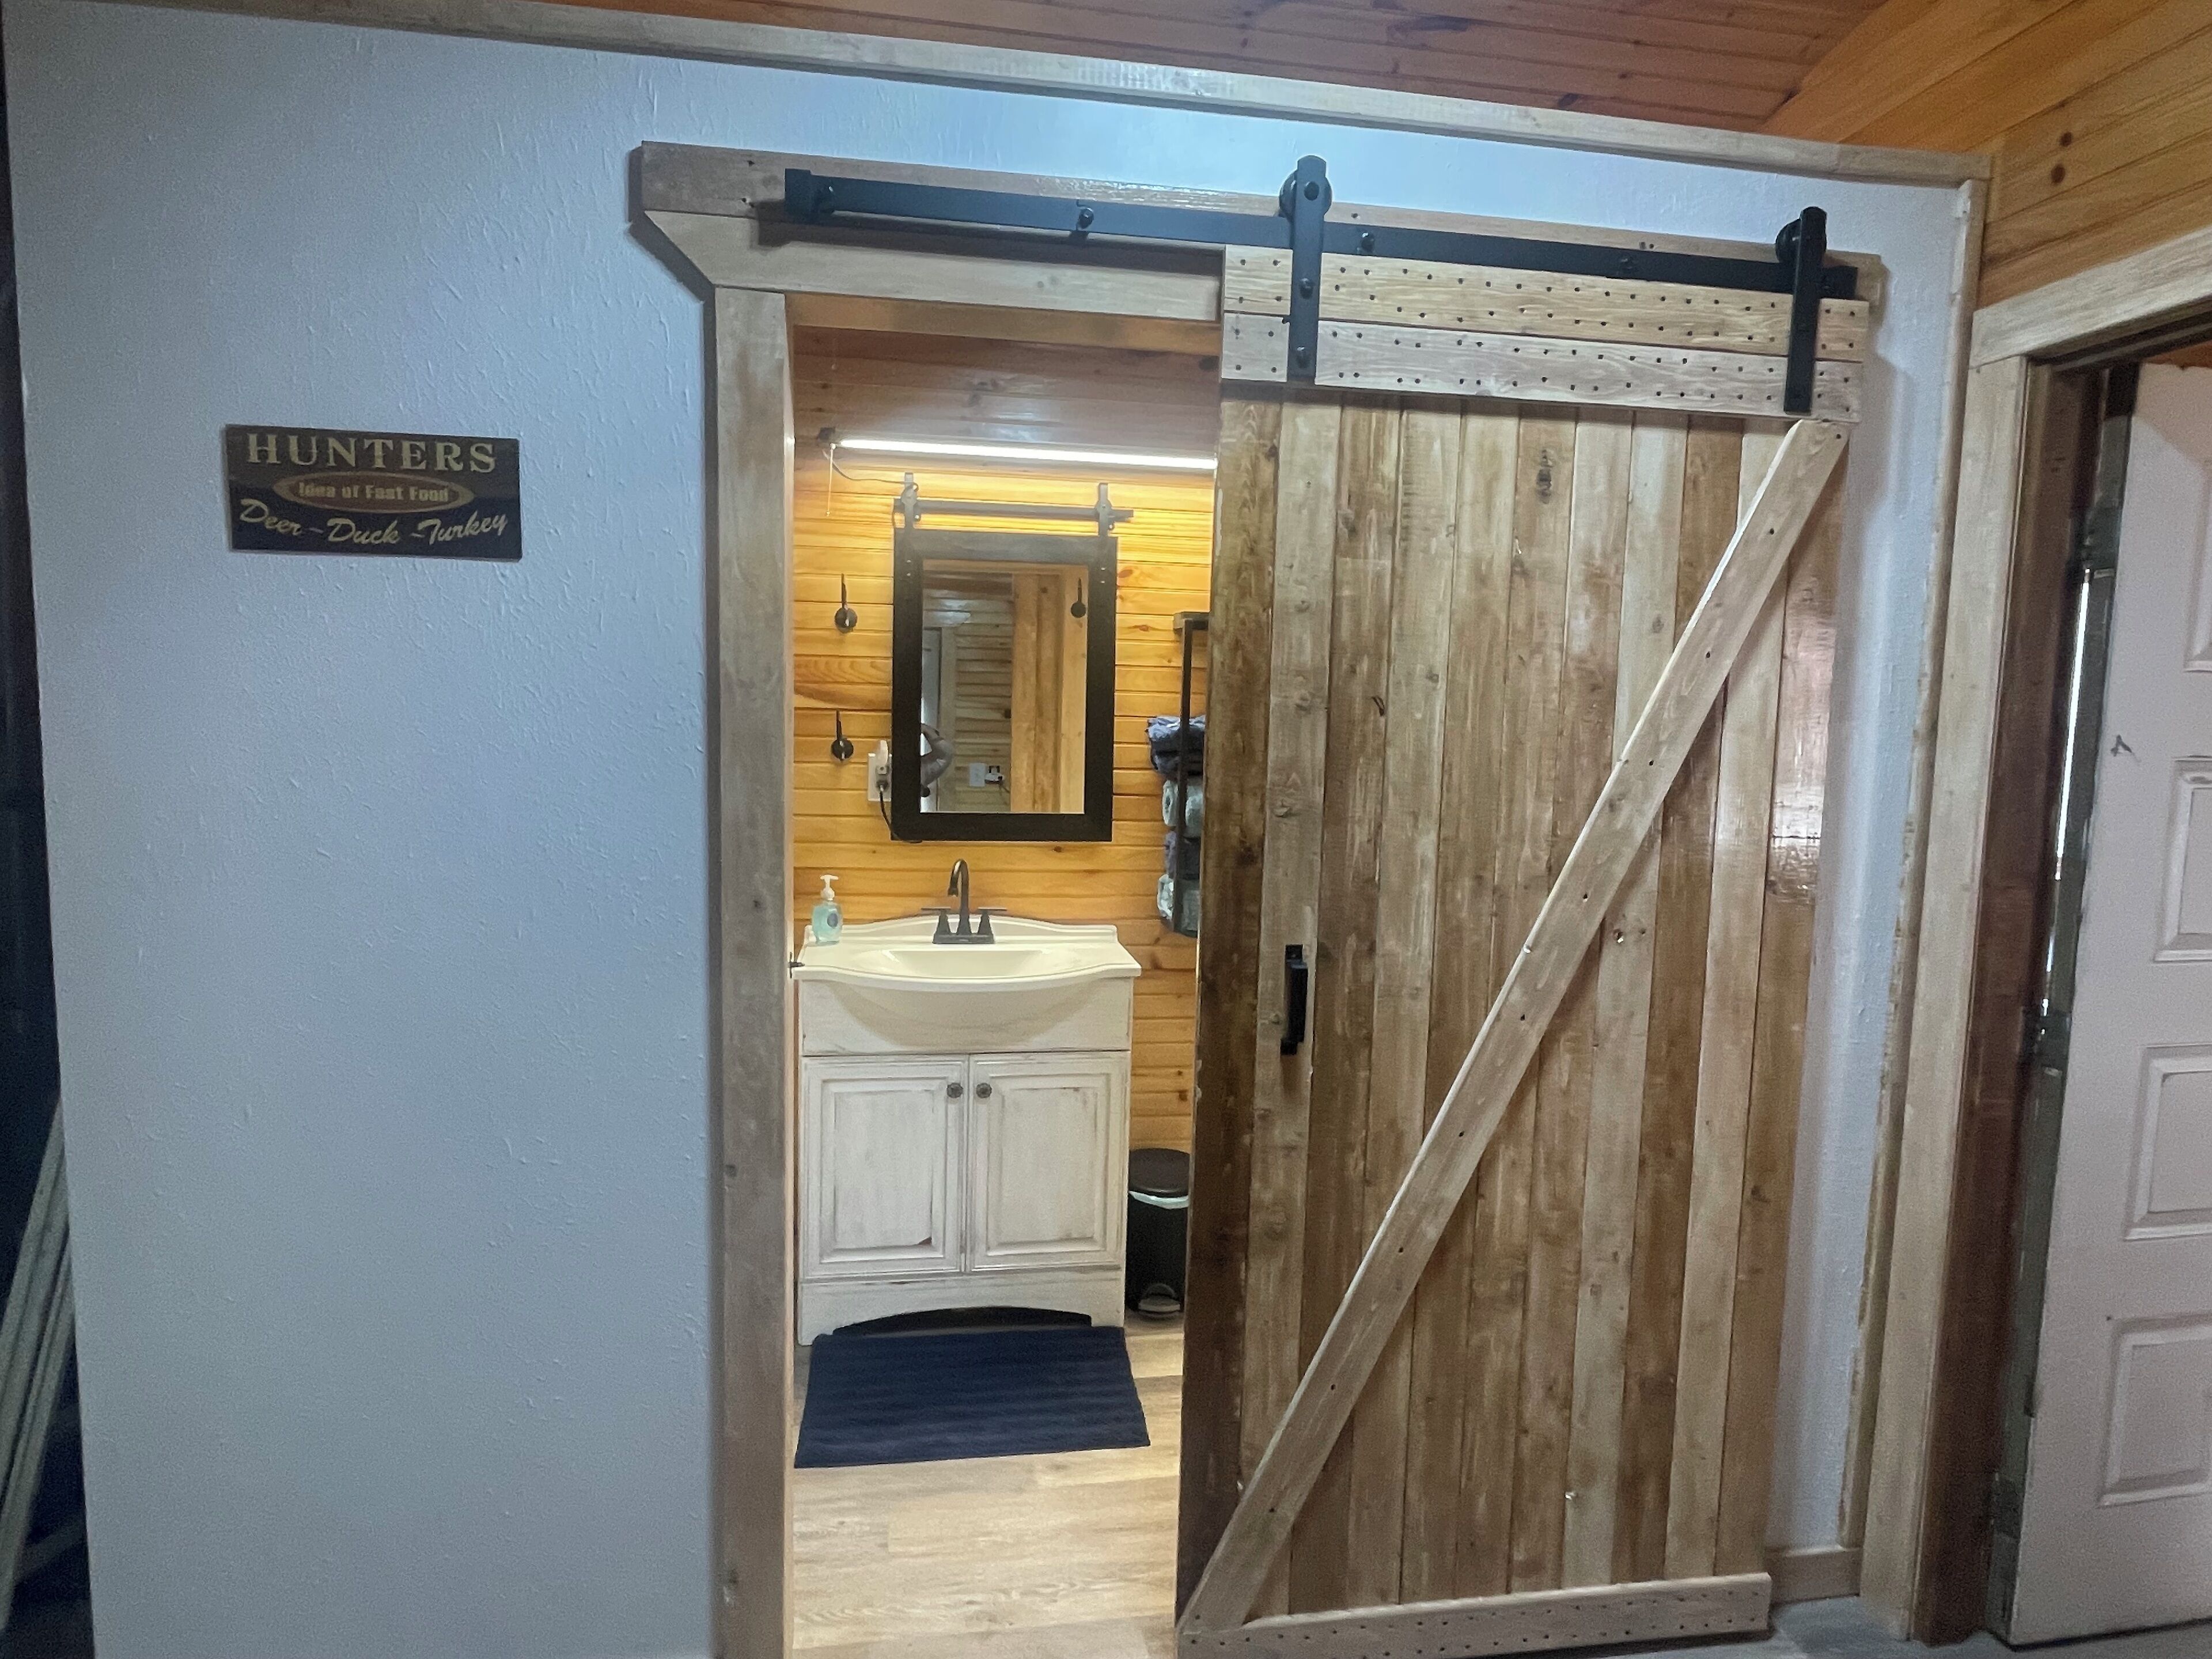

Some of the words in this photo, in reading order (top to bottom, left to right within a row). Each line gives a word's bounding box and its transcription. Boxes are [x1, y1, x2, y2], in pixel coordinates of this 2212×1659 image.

[247, 433, 496, 472] HUNTERS
[299, 482, 335, 498] Idea
[342, 485, 359, 498] of
[365, 485, 404, 500] Fast
[410, 486, 448, 502] Food
[240, 498, 302, 536] Deer
[327, 517, 400, 544] Duck
[418, 510, 507, 545] Turkey
